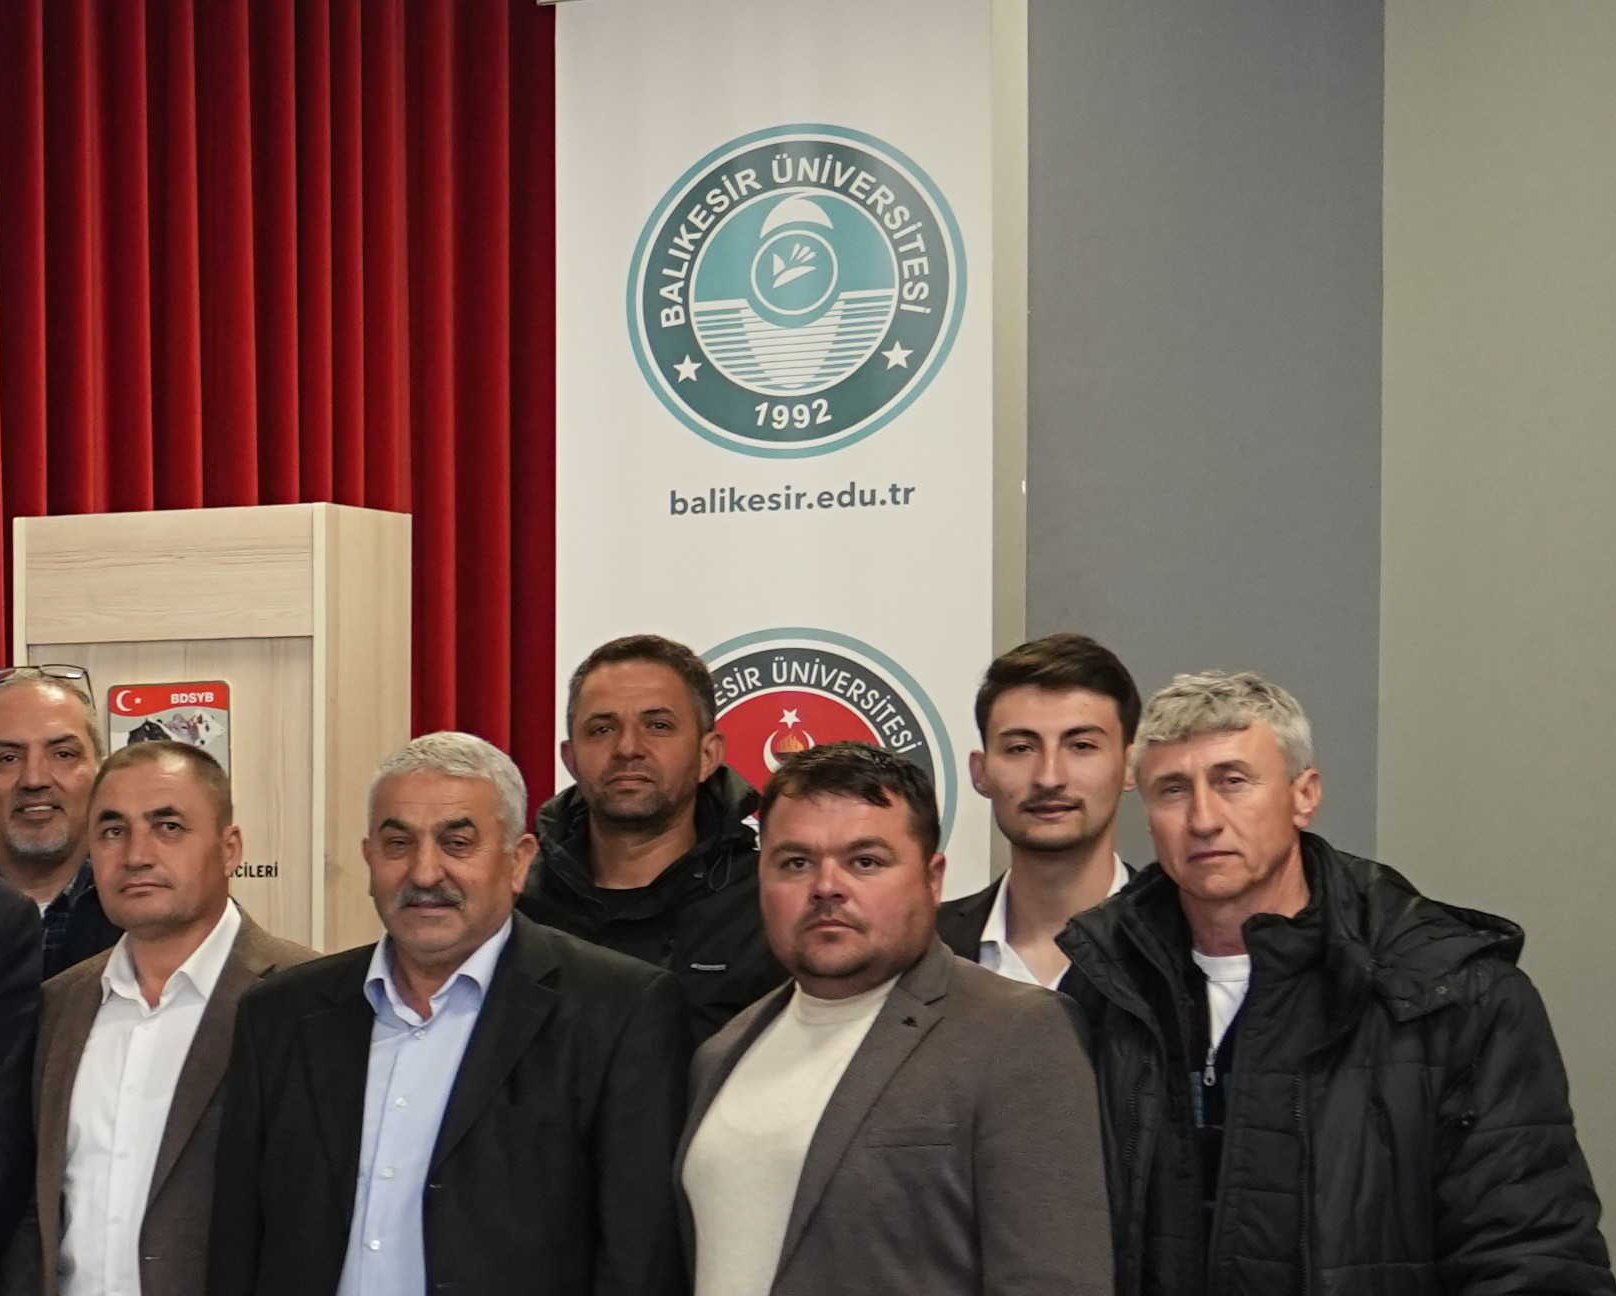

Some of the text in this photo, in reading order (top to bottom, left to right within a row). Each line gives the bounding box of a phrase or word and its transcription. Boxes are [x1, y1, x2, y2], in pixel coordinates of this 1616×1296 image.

[659, 152, 933, 329] BALIKESİR ÜNİVERSİTESİ
[754, 398, 833, 431] 1992
[669, 481, 917, 516] balikesir.edu.tr
[170, 691, 215, 705] BDSYB
[771, 656, 923, 754] ÜNİVERSİTESİ
[234, 861, 278, 878] CİLERİ
